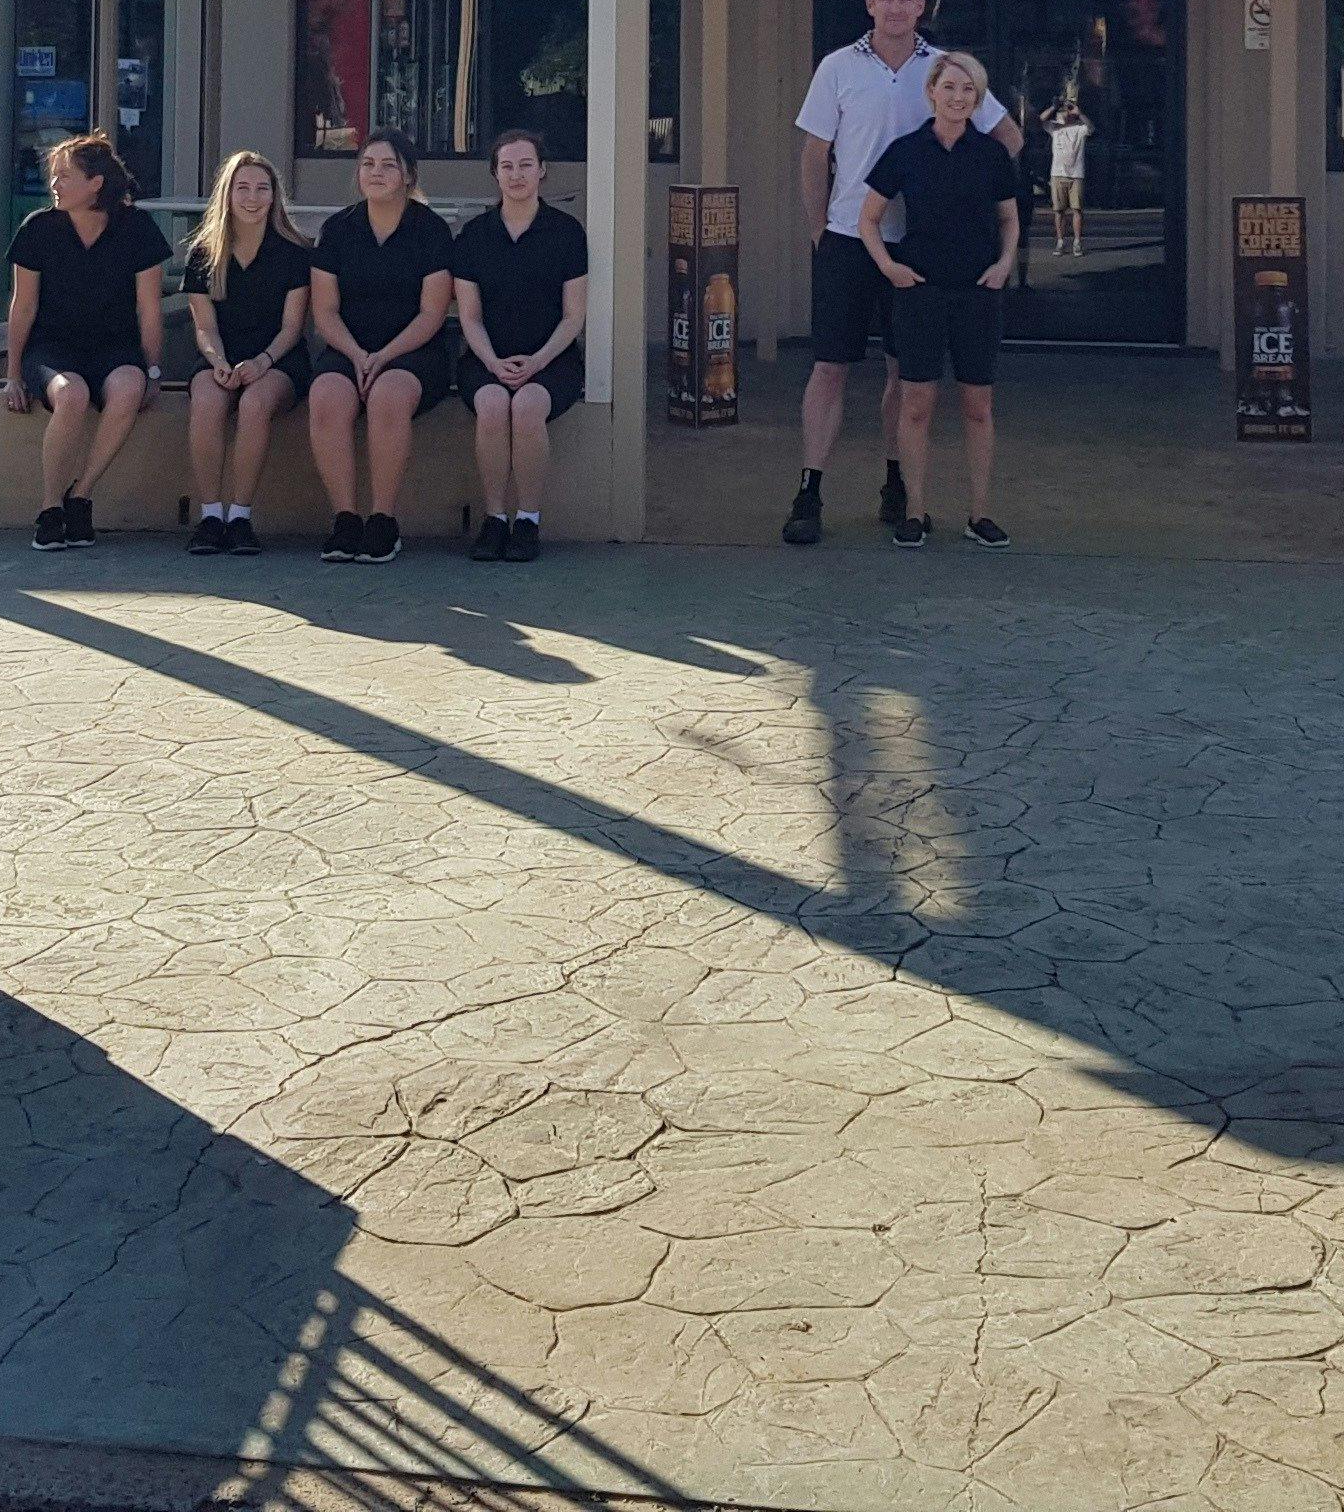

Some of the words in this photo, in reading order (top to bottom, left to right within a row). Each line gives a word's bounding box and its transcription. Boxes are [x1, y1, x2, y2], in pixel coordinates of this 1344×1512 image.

[1239, 202, 1301, 218] MAKES
[1238, 218, 1302, 235] OTHER
[1239, 234, 1302, 249] COFFEE
[673, 318, 690, 341] ICE
[708, 319, 732, 341] ICE
[1252, 332, 1294, 354] ICE
[1252, 353, 1295, 364] BREAK
